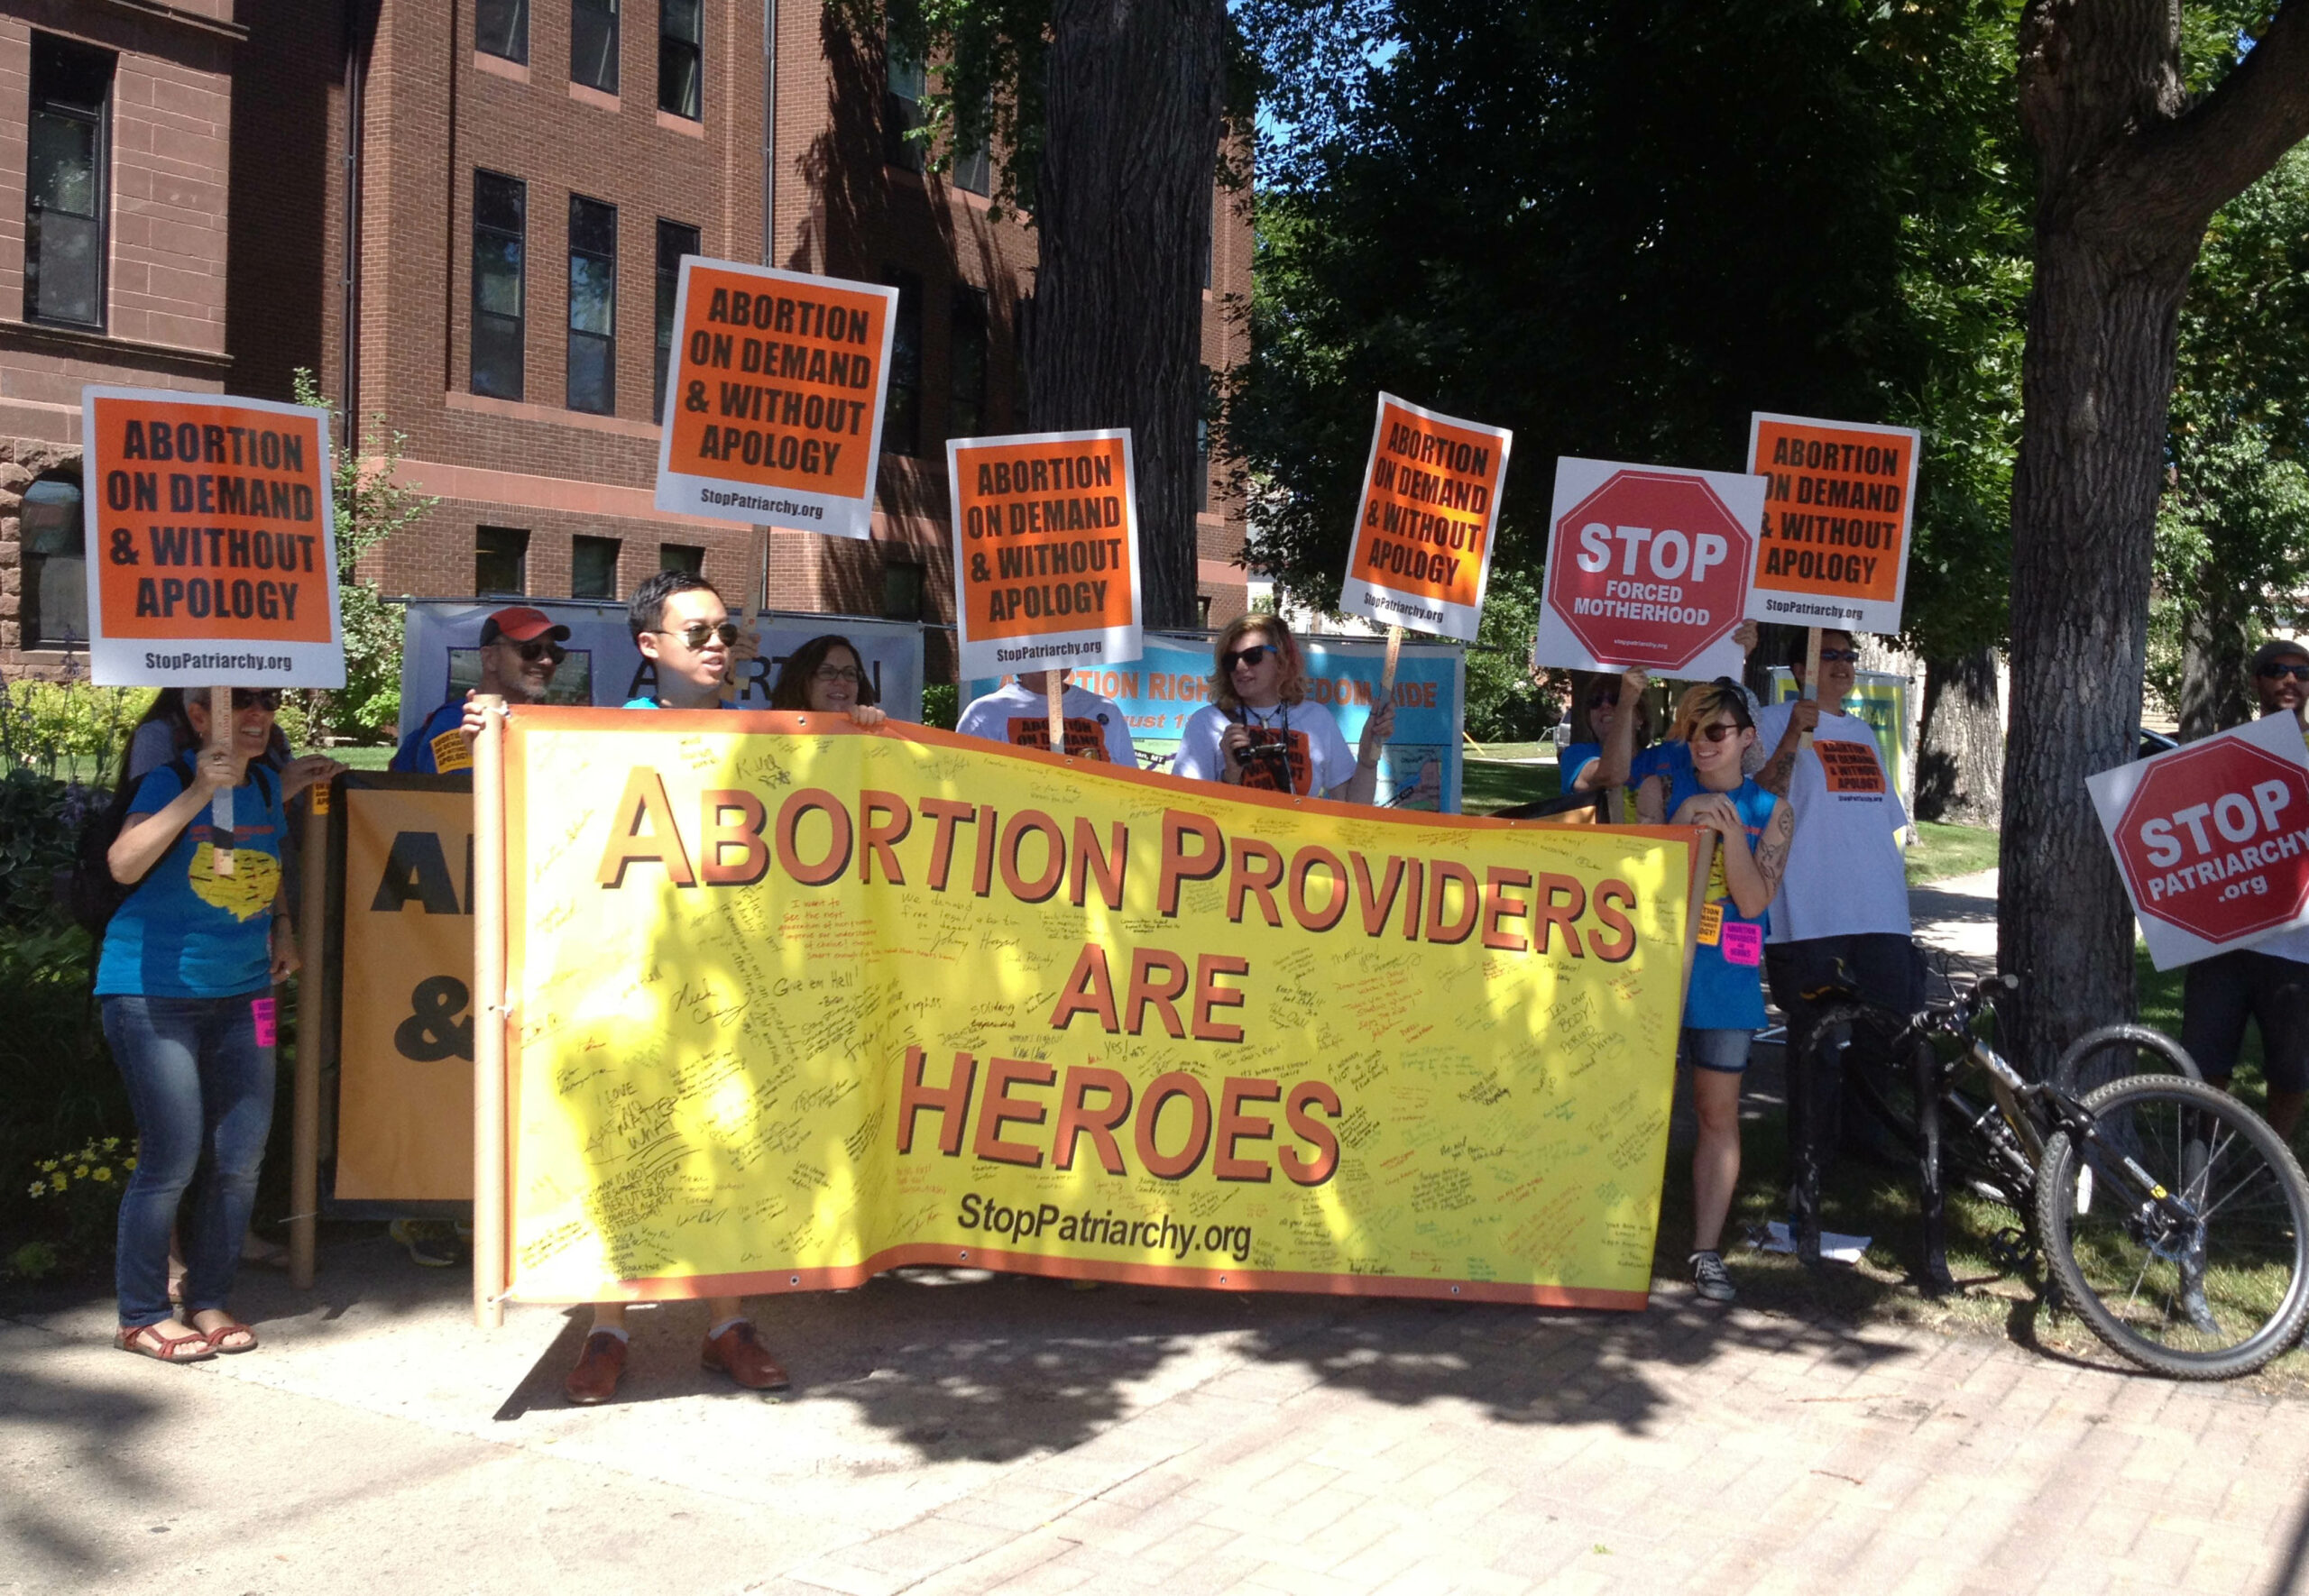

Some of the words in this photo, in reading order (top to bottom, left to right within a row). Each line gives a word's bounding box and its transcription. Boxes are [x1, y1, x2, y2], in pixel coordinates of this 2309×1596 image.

[708, 289, 868, 344] ABORTION
[690, 330, 731, 369] ON
[741, 337, 870, 390] DEMAND
[685, 381, 710, 414] &
[720, 381, 866, 436] WITHOUT
[124, 420, 302, 472] ABORTION
[700, 425, 841, 475] APOLOGY
[1387, 422, 1488, 477] ABORTION
[1773, 437, 1898, 476] ABORTION
[107, 471, 158, 513] ON
[170, 473, 314, 521] DEMAND
[978, 454, 1111, 497] ABORTION
[1375, 457, 1397, 488] ON
[1398, 465, 1487, 515] DEMAND
[1797, 477, 1900, 513] DEMAND
[700, 488, 823, 521] StopPatriarchy.org
[968, 507, 1002, 538] ON
[1009, 497, 1120, 535] DEMAND
[1367, 499, 1379, 527] &
[1382, 503, 1481, 553] WITHOUT
[109, 527, 139, 564] &
[150, 526, 315, 573] WITHOUT
[1577, 522, 1727, 582] STOP
[1781, 515, 1897, 550] WITHOUT
[971, 549, 990, 582] &
[996, 538, 1122, 576] WITHOUT
[1368, 537, 1460, 586] APOLOGY
[1765, 547, 1878, 584] APOLOGY
[135, 577, 299, 620] APOLOGY
[989, 582, 1108, 622] APOLOGY
[1364, 592, 1443, 623] StopPatriarchy.org
[1573, 597, 1710, 626] MOTHERHOOD
[1605, 580, 1682, 603] FORCED
[1766, 599, 1863, 620] StopPatriarchy.org
[145, 652, 292, 672] StopPatriarchy.org
[997, 640, 1102, 662] StopPatriarchy.org
[2140, 779, 2290, 867] STOP
[596, 766, 1128, 912] ABORTION
[1156, 808, 1637, 962] PROVIDERS
[2148, 828, 2309, 902] PATRIARCHY
[2218, 874, 2268, 902] .org
[1049, 942, 1250, 1044] ARE
[897, 1044, 1342, 1186] HEROES
[958, 1193, 1252, 1260] StopPatriarchy.org
